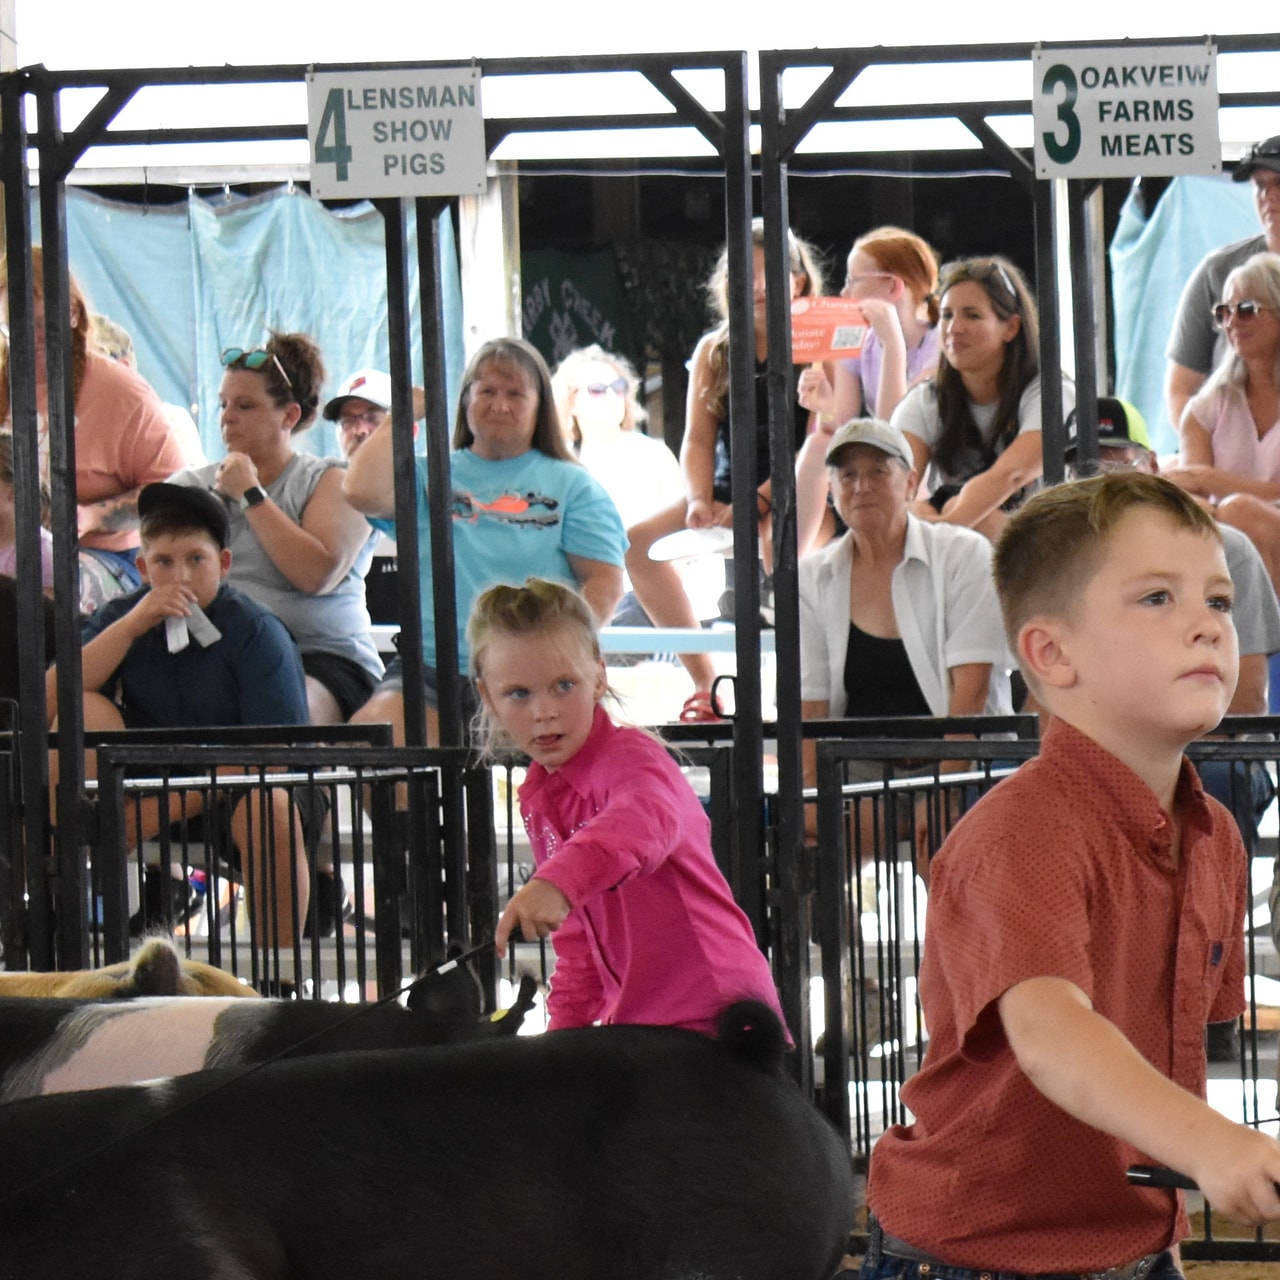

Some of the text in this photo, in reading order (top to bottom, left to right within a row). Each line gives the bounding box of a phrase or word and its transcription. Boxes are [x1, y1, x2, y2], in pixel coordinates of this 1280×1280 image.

[1080, 64, 1211, 90] OAKVEIW
[347, 85, 475, 111] LENSMAN
[1041, 63, 1081, 165] 3
[1098, 99, 1194, 123] FARMS
[315, 88, 352, 181] 4
[372, 119, 453, 144] SHOW
[1100, 133, 1195, 157] MEATS
[383, 152, 446, 176] PIGS
